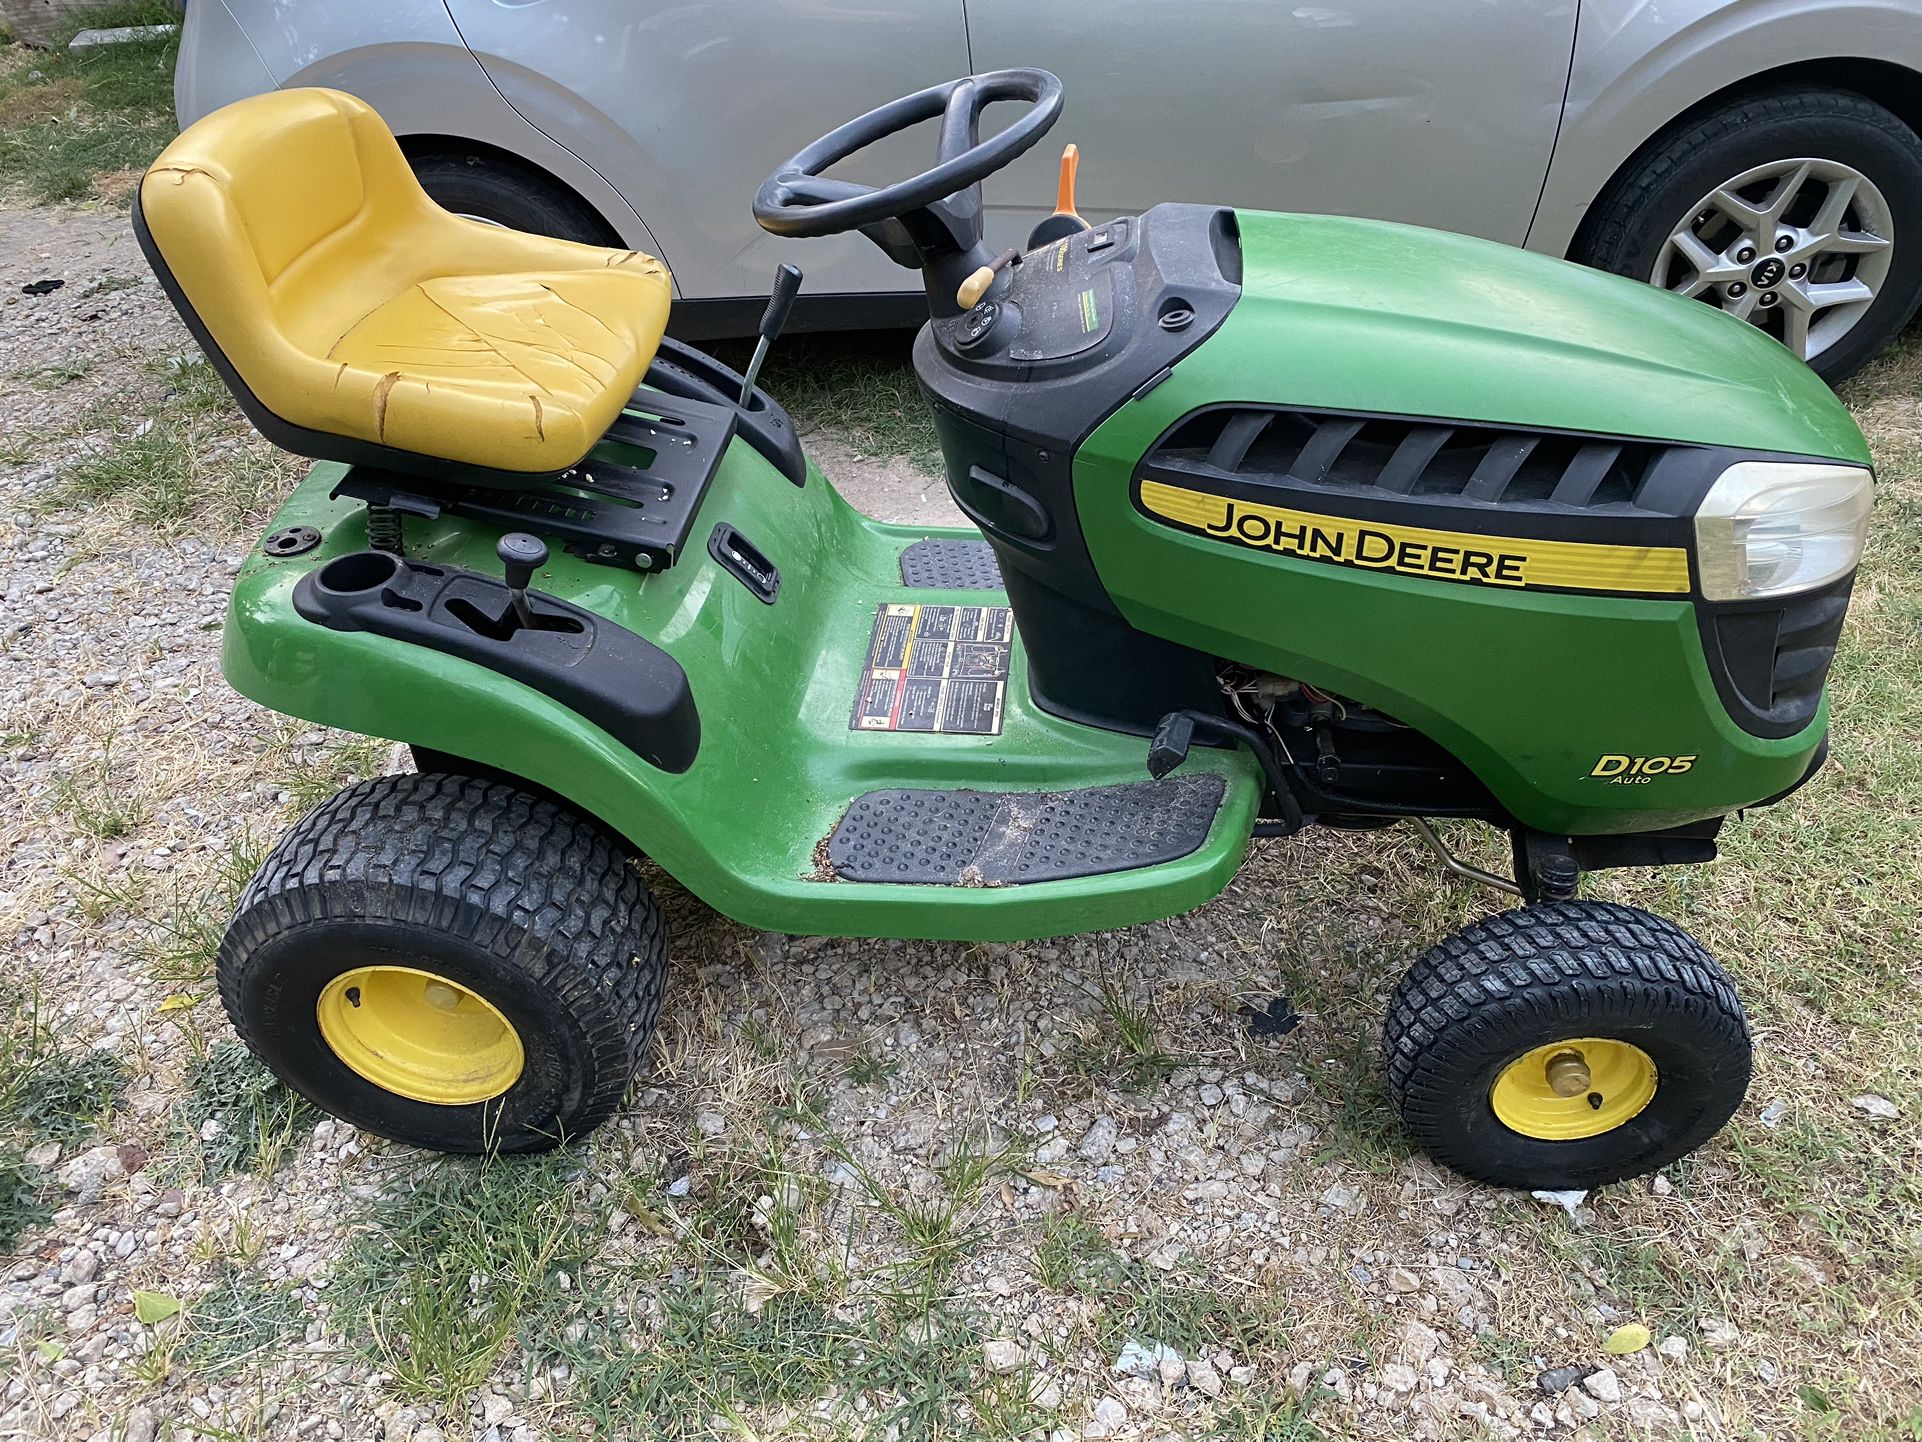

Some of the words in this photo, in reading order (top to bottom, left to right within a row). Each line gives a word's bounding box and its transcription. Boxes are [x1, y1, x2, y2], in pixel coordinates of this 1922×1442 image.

[1757, 261, 1779, 285] KIA
[1206, 503, 1343, 557] JOHN
[1355, 530, 1527, 582] DEERE
[1590, 755, 1697, 776] D105
[1609, 776, 1651, 785] Auto
